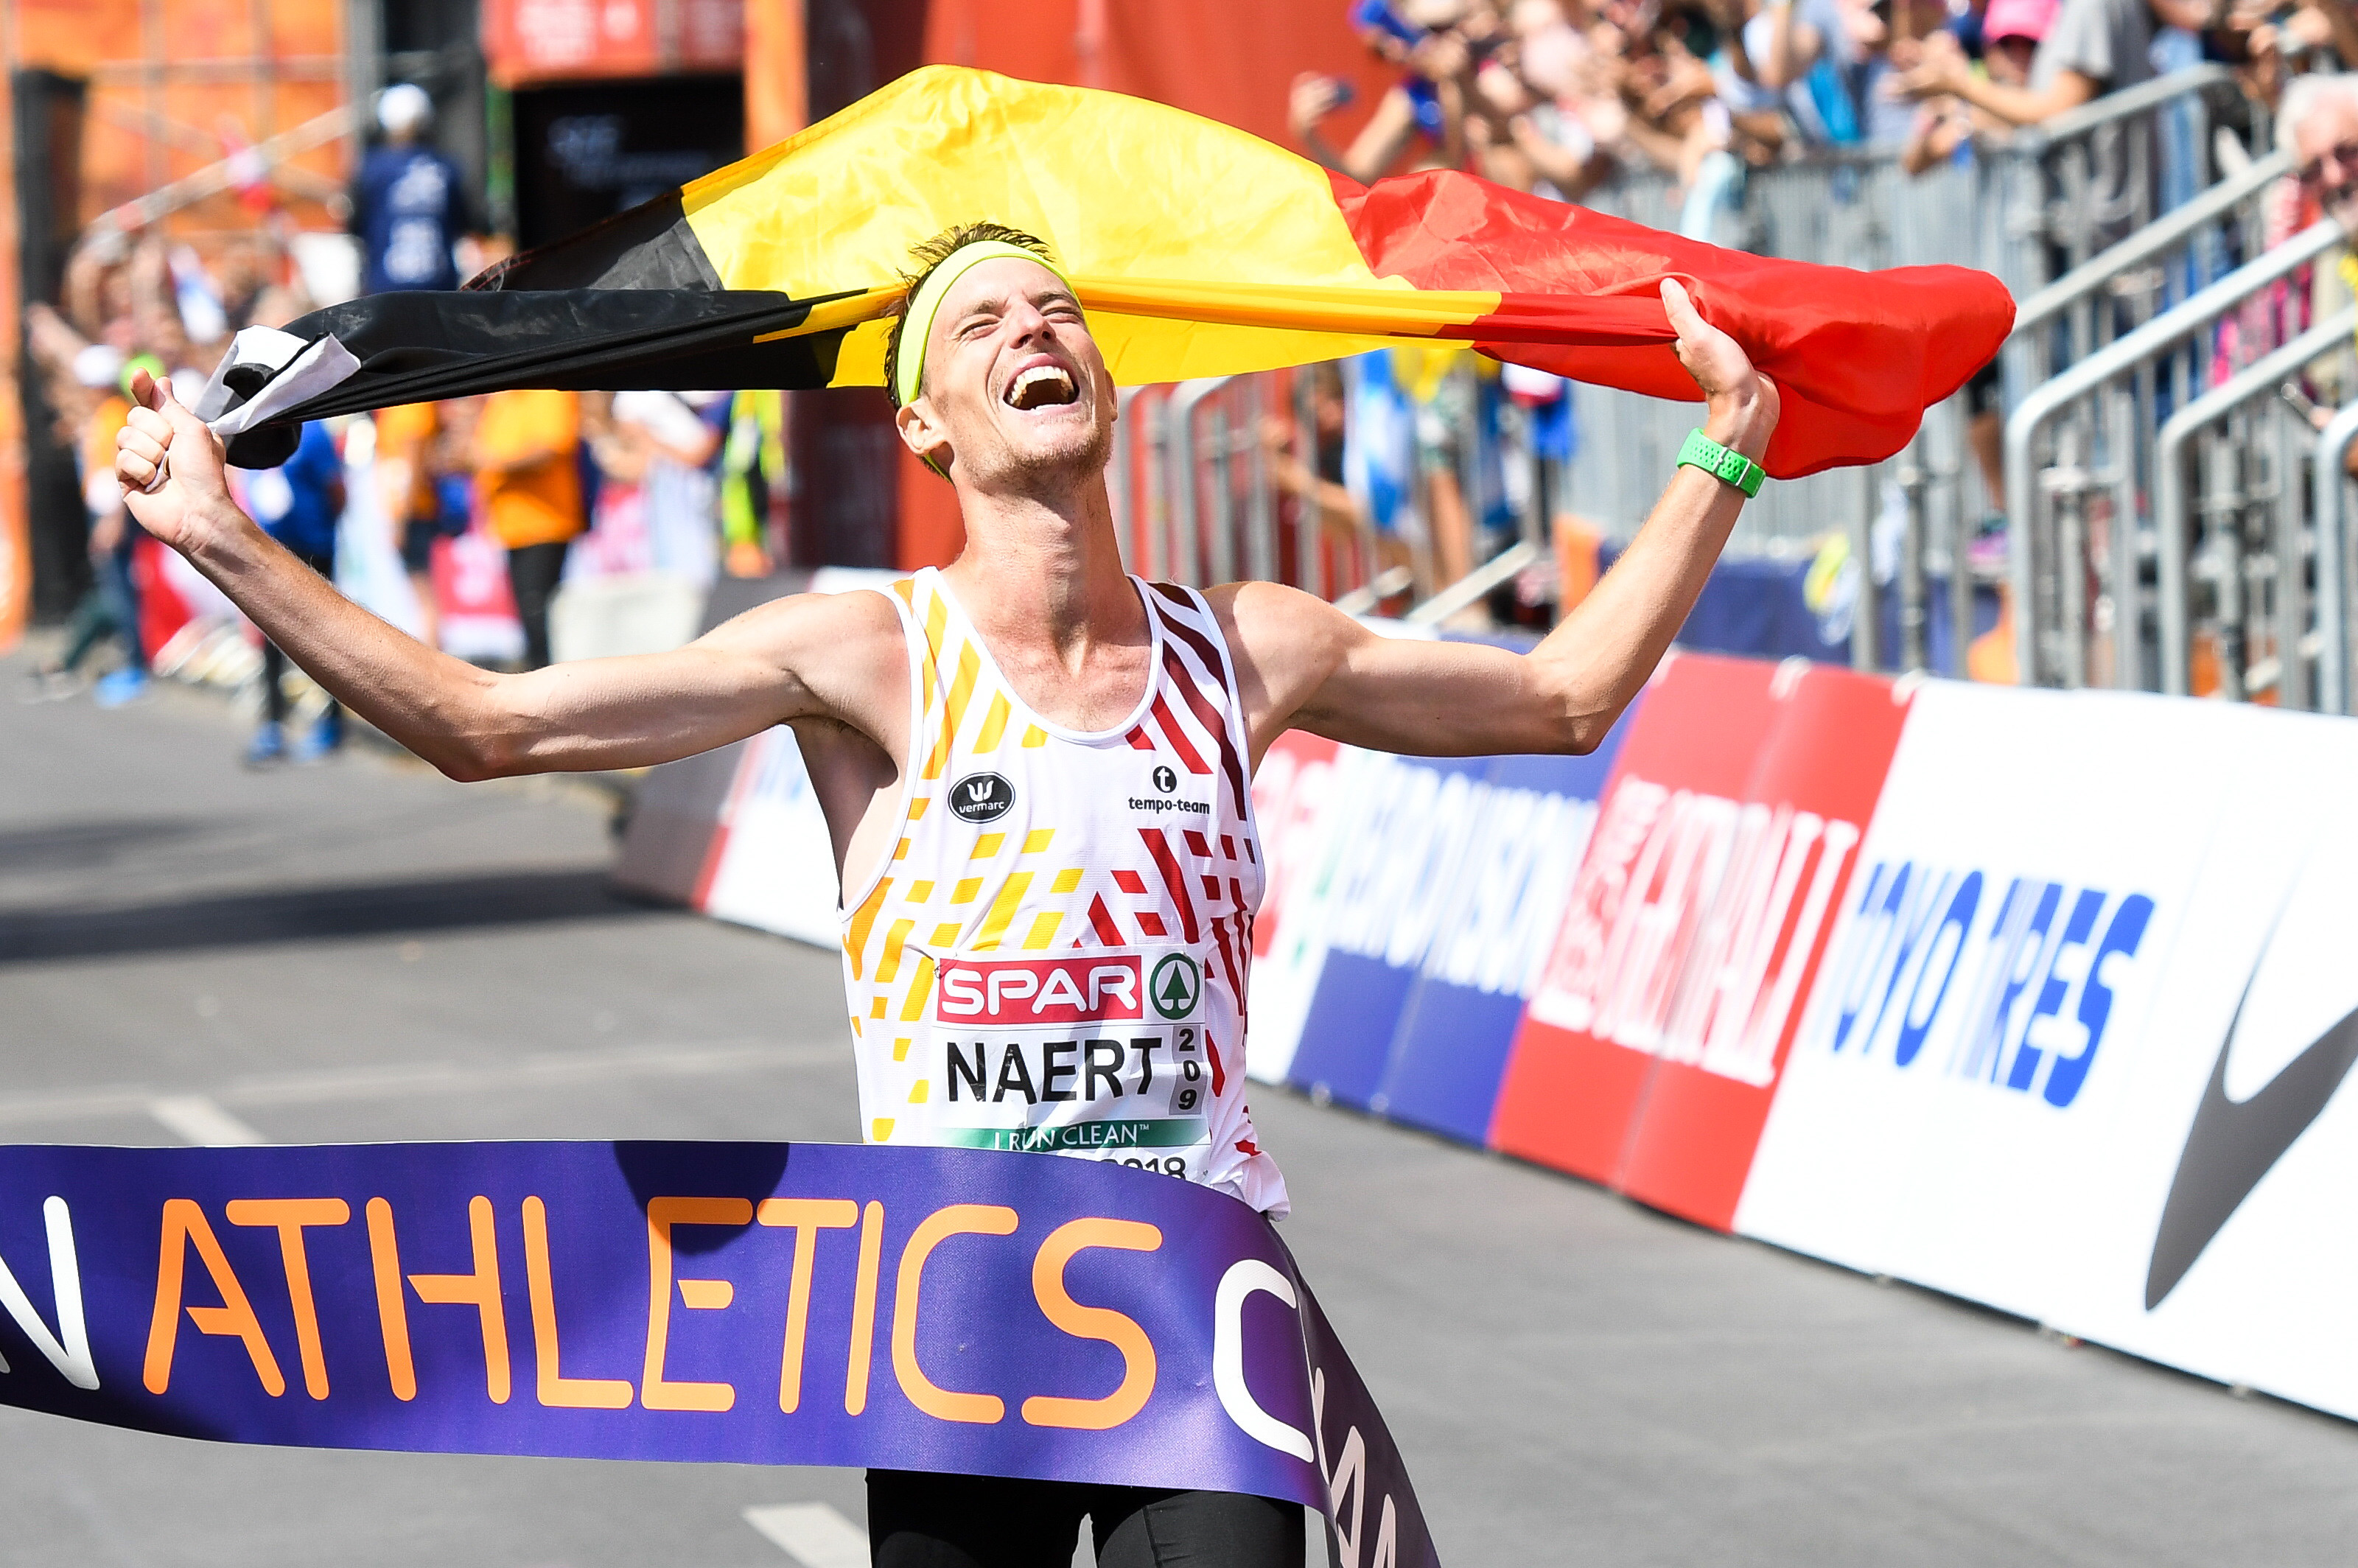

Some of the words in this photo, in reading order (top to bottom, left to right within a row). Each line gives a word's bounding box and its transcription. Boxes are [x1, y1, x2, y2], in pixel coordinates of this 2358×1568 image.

[959, 800, 1005, 813] vermarc
[1127, 797, 1210, 815] tempo-team
[941, 967, 1138, 1016] SPAR
[1809, 860, 1983, 1068] TOYO
[1945, 877, 2155, 1108] TIRES
[947, 1037, 1163, 1105] NAERT
[1009, 1130, 1055, 1151] RUN
[143, 1195, 1163, 1431] ATHLETICS
